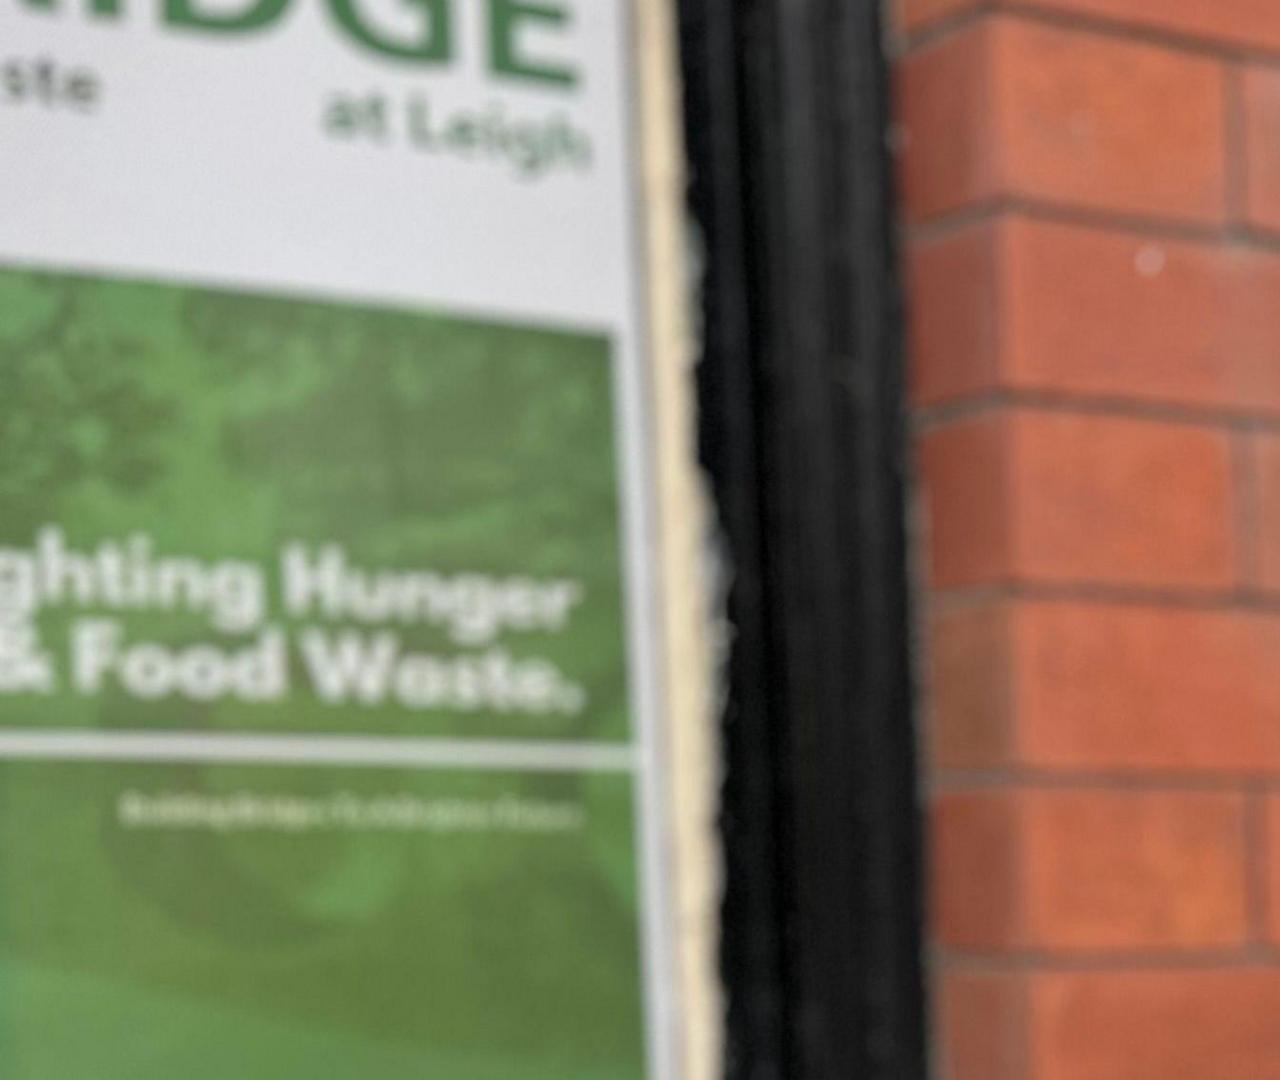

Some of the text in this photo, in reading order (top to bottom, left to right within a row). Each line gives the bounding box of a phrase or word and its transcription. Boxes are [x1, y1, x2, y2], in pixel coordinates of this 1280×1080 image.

[323, 91, 592, 181] at Leigh
[281, 543, 581, 645] Hunger
[73, 618, 285, 698] Food
[300, 628, 585, 713] Waste.
